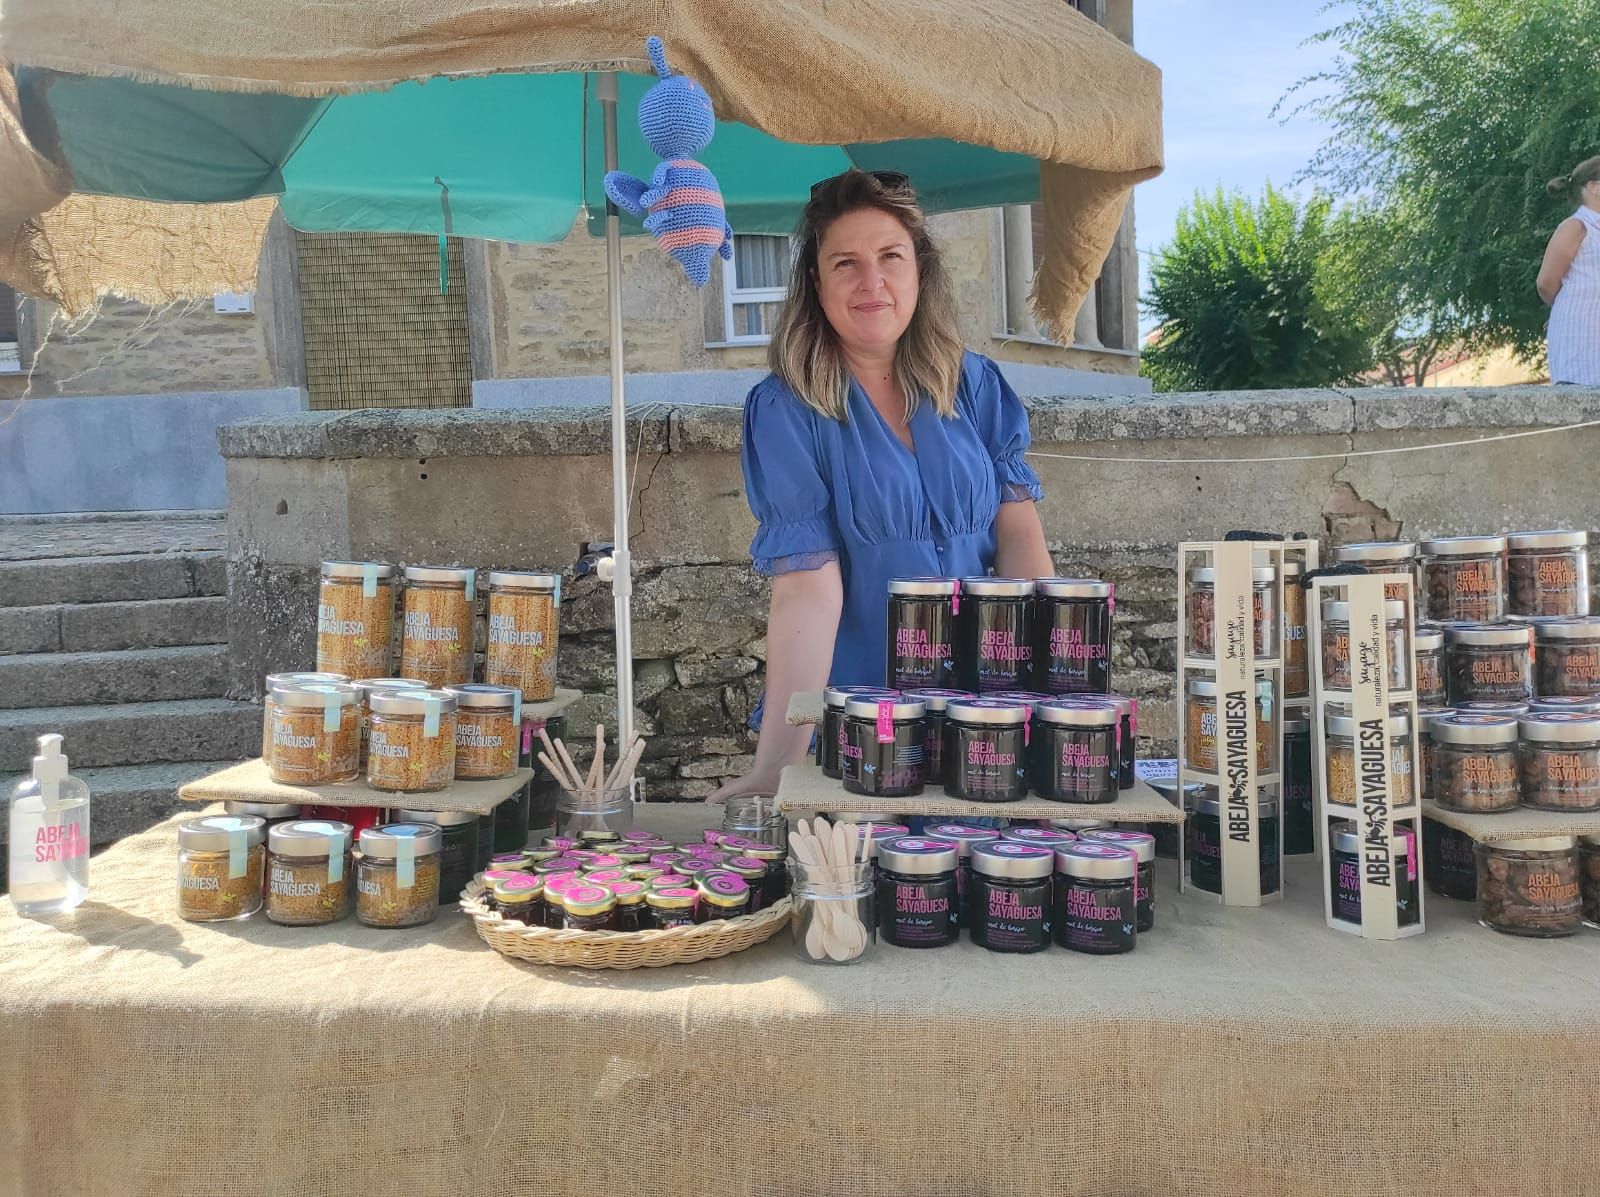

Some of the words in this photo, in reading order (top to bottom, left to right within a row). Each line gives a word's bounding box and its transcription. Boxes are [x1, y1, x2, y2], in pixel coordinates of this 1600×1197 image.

[1539, 561, 1566, 572] ABEJA
[1456, 570, 1484, 581] ABEJA
[405, 611, 431, 626] ABEJA
[490, 615, 516, 631] ABEJA
[1369, 614, 1379, 631] vida
[404, 626, 459, 641] SAYAGUESA
[489, 629, 543, 646] SAYAGUESA
[896, 629, 927, 644] ABEJA
[980, 631, 1015, 646] ABEJA
[1049, 629, 1081, 644] ABEJA
[896, 643, 952, 660] SAYAGUESA
[1049, 643, 1106, 660] SAYAGUESA
[1370, 637, 1380, 664] calidad
[1472, 661, 1501, 673] ABEJA
[1566, 656, 1595, 667] ABEJA
[1201, 713, 1217, 725] ABE
[456, 735, 502, 748] SAYAGUESA
[1226, 690, 1249, 782] SAYAGUESA
[968, 741, 995, 754] ABEJA
[1062, 742, 1090, 756] ABEJA
[968, 753, 1016, 767] SAYAGUESA
[1062, 755, 1110, 768] SAYAGUESA
[1360, 718, 1388, 815] SAYAGUESA
[1463, 758, 1495, 770] ABEJA
[1547, 756, 1581, 768] ABEJA
[1463, 768, 1517, 783] SAYAGUESA
[1365, 835, 1391, 888] ABEJA
[1527, 873, 1560, 887] ABEJA
[270, 882, 320, 897] SAYAGUESA
[896, 885, 926, 900] ABEJA
[989, 889, 1020, 906] ABEJA
[1067, 889, 1097, 906] ABEJA
[896, 898, 949, 914] SAYAGUESA
[989, 904, 1042, 920] SAYAGUESA
[1067, 904, 1122, 921] SAYAGUESA
